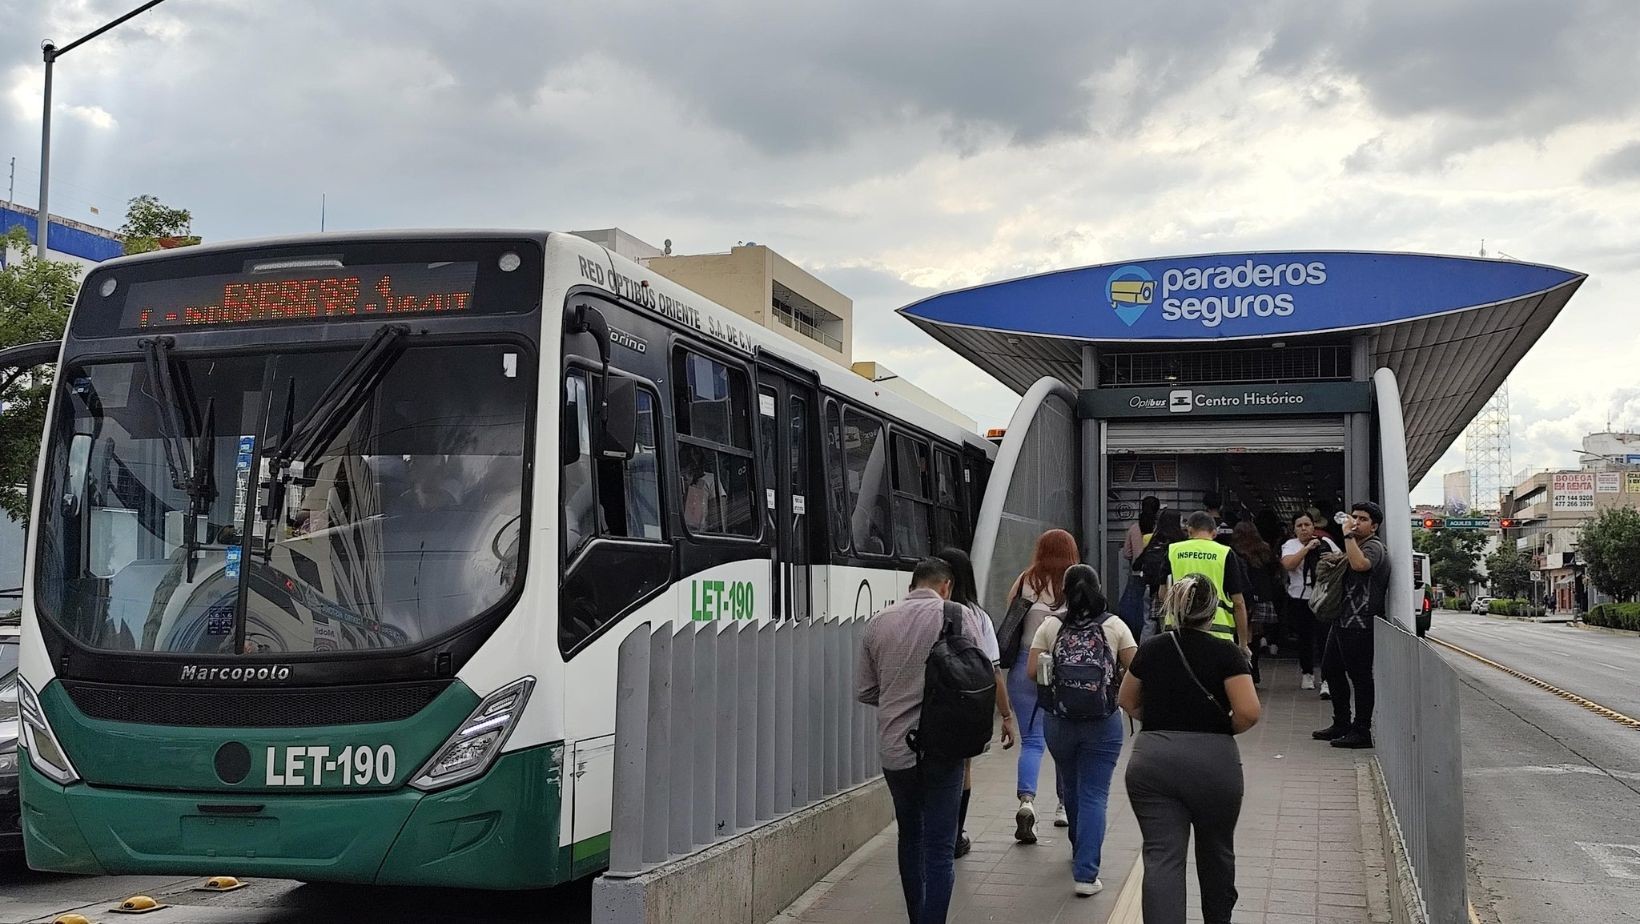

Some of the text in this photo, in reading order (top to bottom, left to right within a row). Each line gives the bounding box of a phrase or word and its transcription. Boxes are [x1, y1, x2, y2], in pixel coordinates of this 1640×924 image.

[1162, 259, 1327, 298] paraderos
[578, 254, 605, 286] RED
[607, 269, 656, 310] OPTIBUS
[658, 292, 701, 329] ORIENTE
[708, 315, 726, 340] S.A.
[726, 324, 739, 346] DE
[1161, 293, 1295, 328] seguros
[610, 329, 646, 353] orino
[1129, 391, 1304, 409] Optibus Centro Histórico
[1554, 482, 1565, 491] EN
[1566, 482, 1593, 491] RENTA
[1555, 474, 1593, 482] BODEGA
[1177, 551, 1218, 561] INSPECTOR
[691, 579, 754, 622] LET-190
[181, 664, 291, 682] Marcopolo
[265, 744, 397, 787] LET-190
